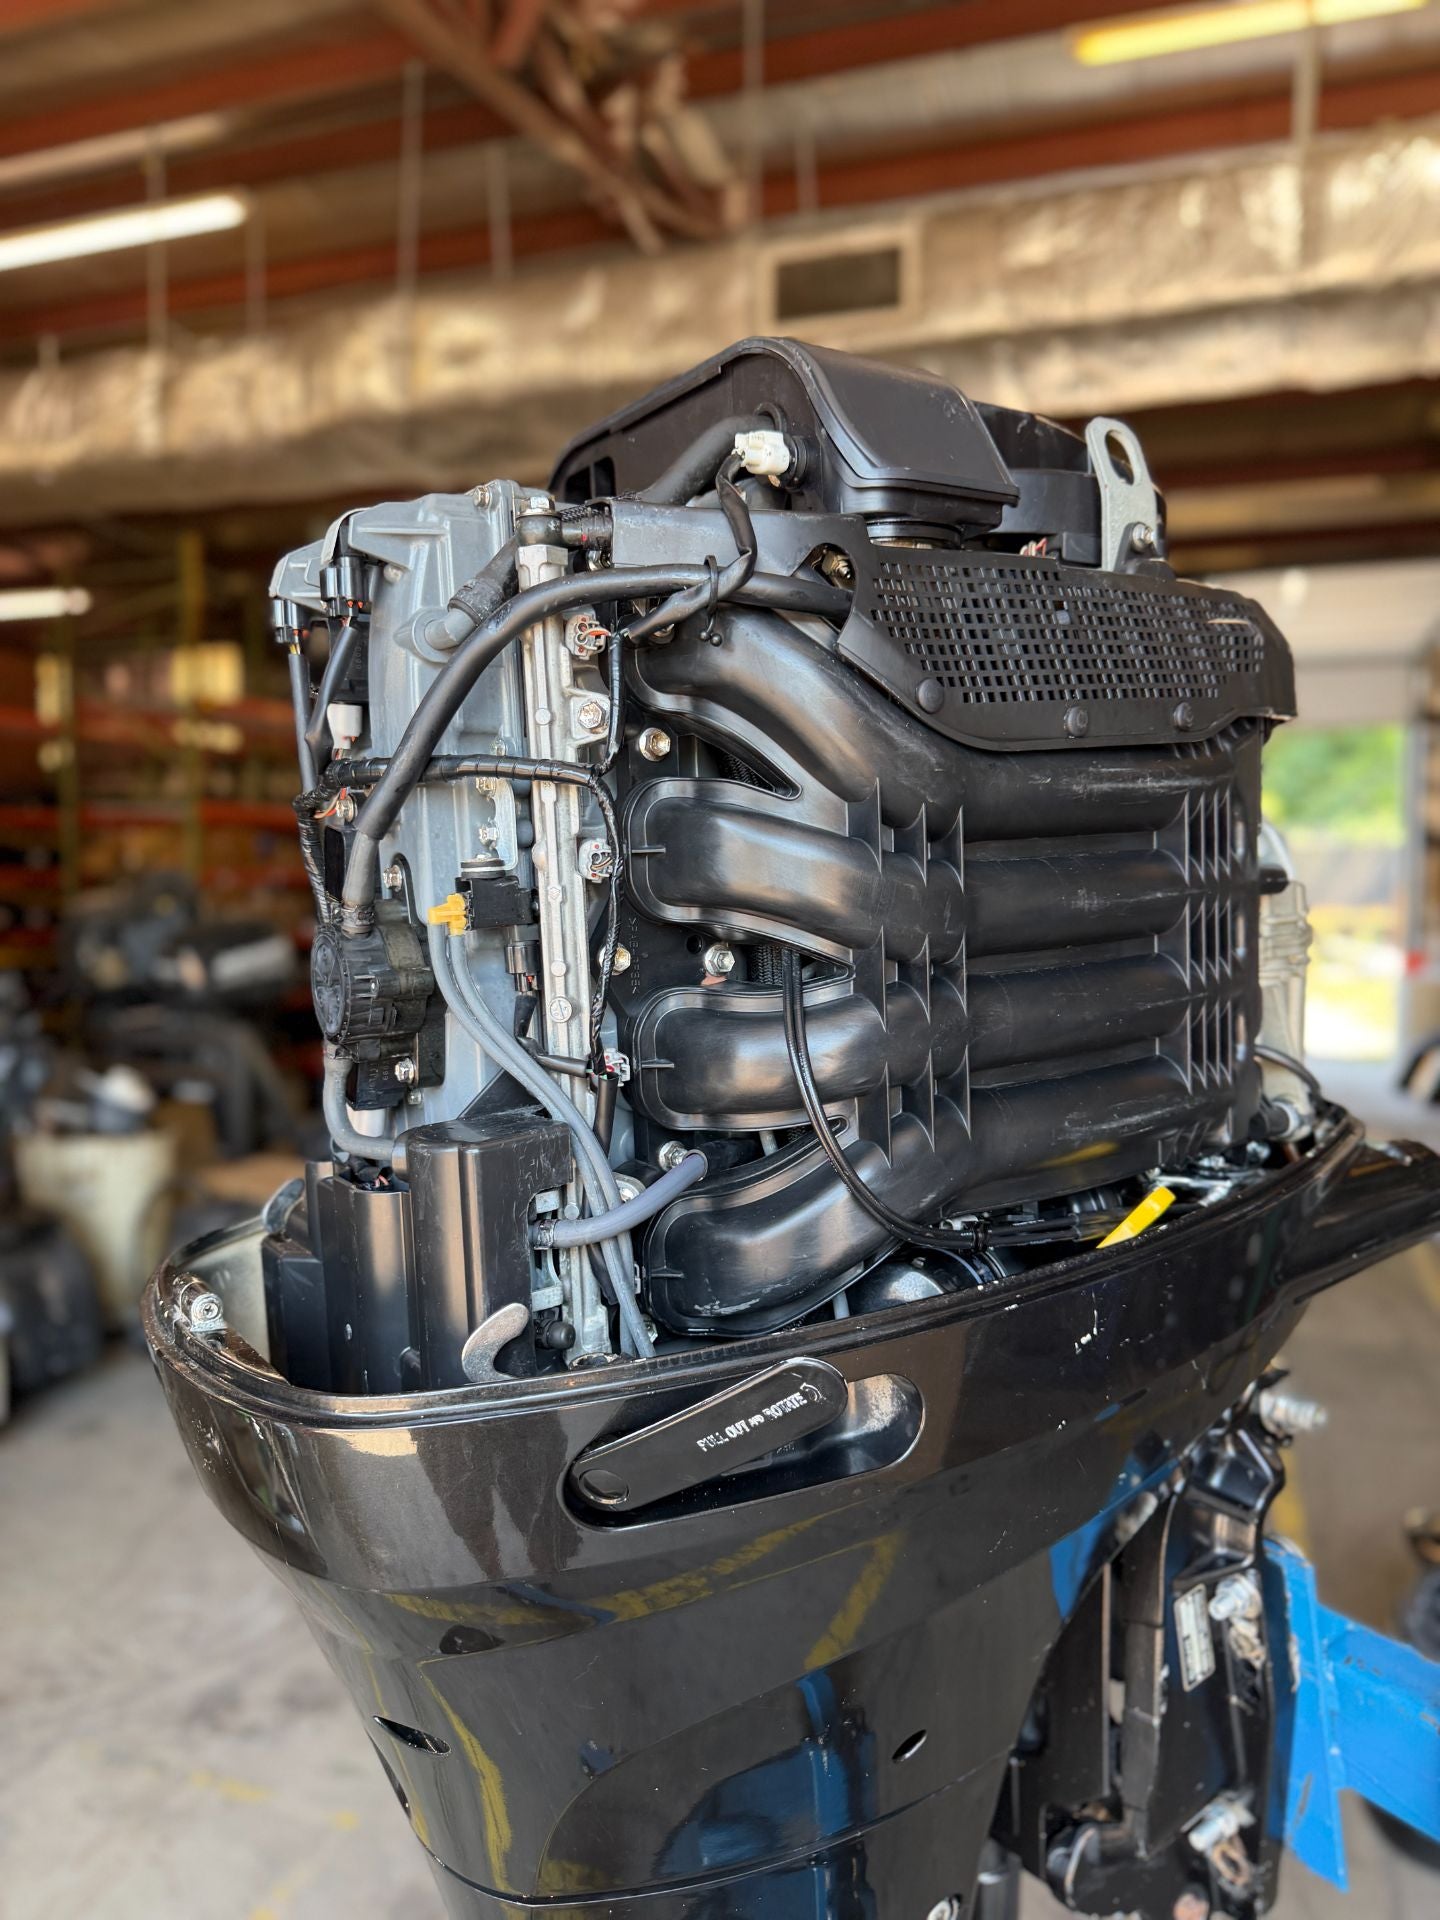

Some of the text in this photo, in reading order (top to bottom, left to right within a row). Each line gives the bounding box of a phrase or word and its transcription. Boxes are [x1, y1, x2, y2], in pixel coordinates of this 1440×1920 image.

[696, 1432, 729, 1452] PULL
[725, 1420, 750, 1438] OUT
[762, 1391, 808, 1420] ROTATE
